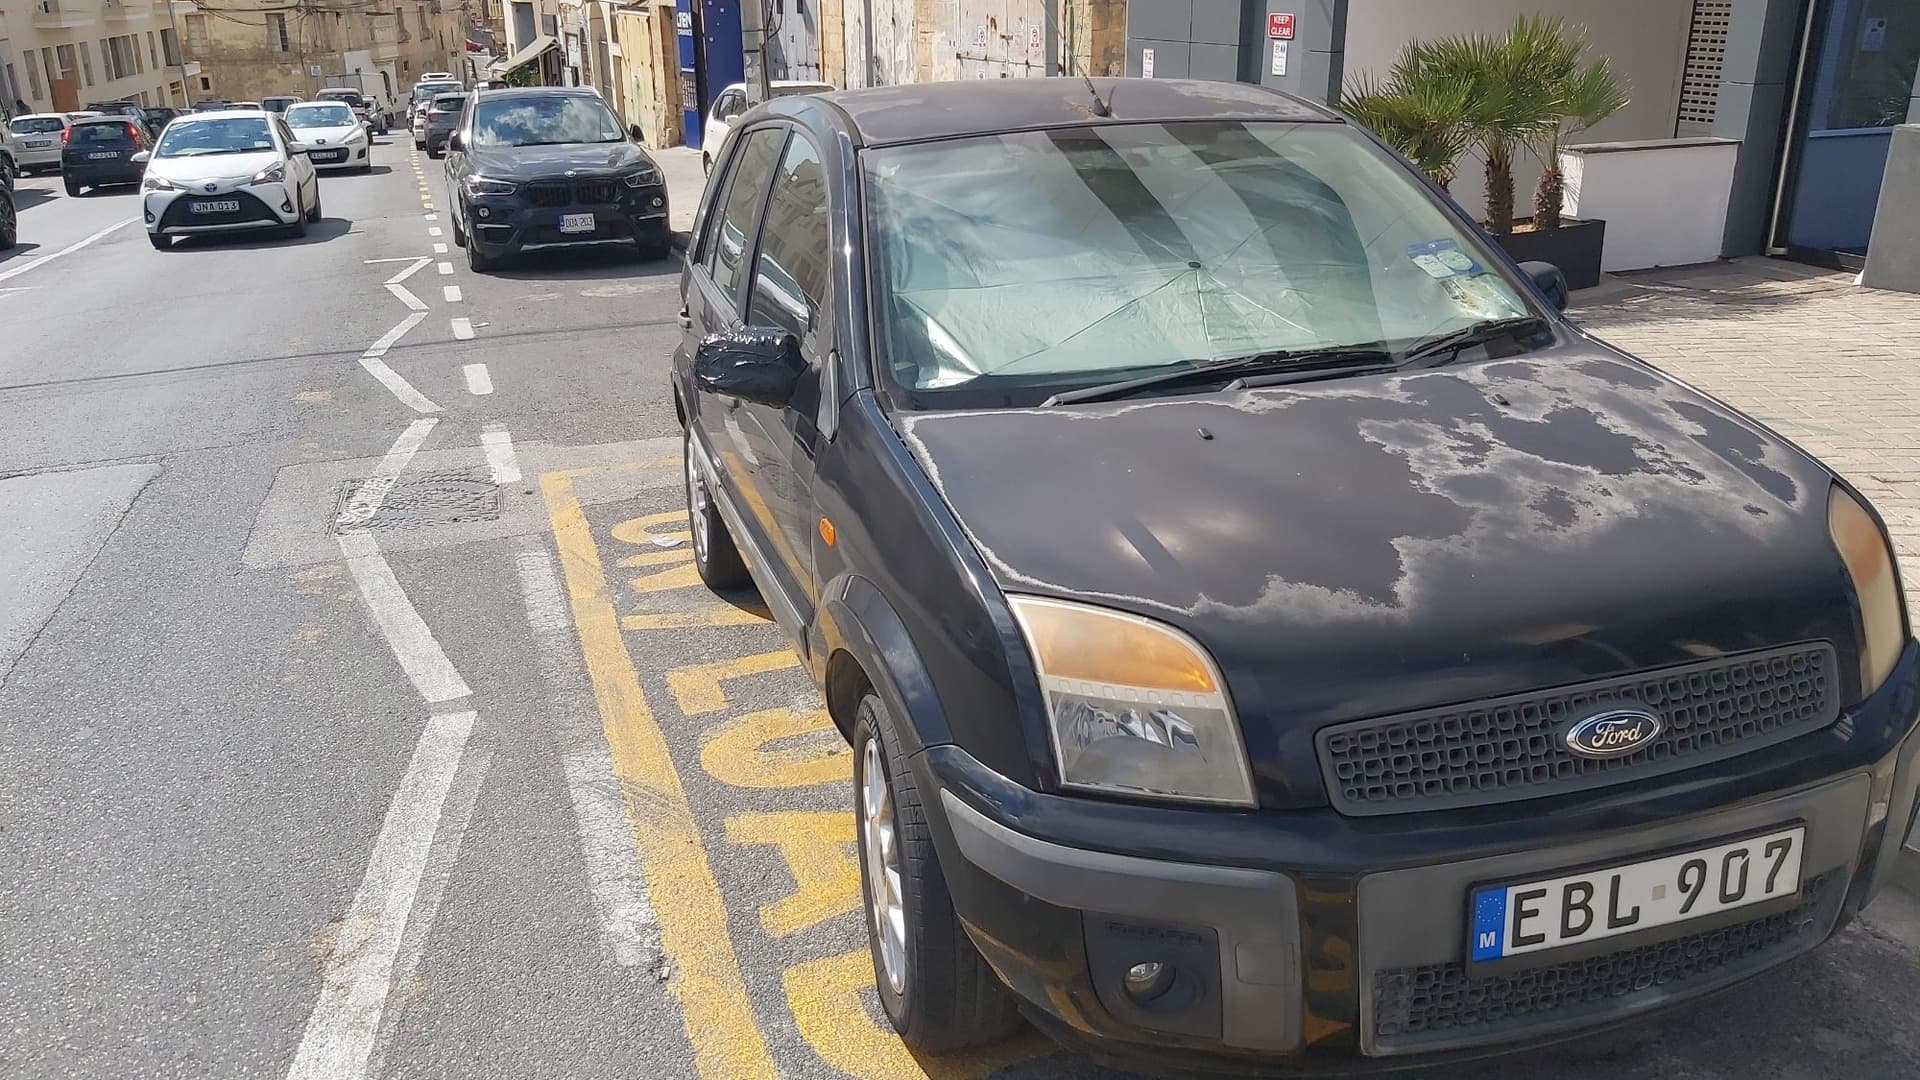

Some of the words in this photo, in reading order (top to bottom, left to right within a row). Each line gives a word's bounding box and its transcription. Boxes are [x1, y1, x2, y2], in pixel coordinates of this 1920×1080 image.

[1273, 15, 1290, 25] KEEP
[1270, 26, 1292, 36] CLEAR
[196, 202, 215, 211] JNA
[1591, 718, 1642, 748] Ford
[1511, 874, 1641, 949] EBL
[1676, 837, 1794, 915] 907
[1478, 930, 1497, 949] M
